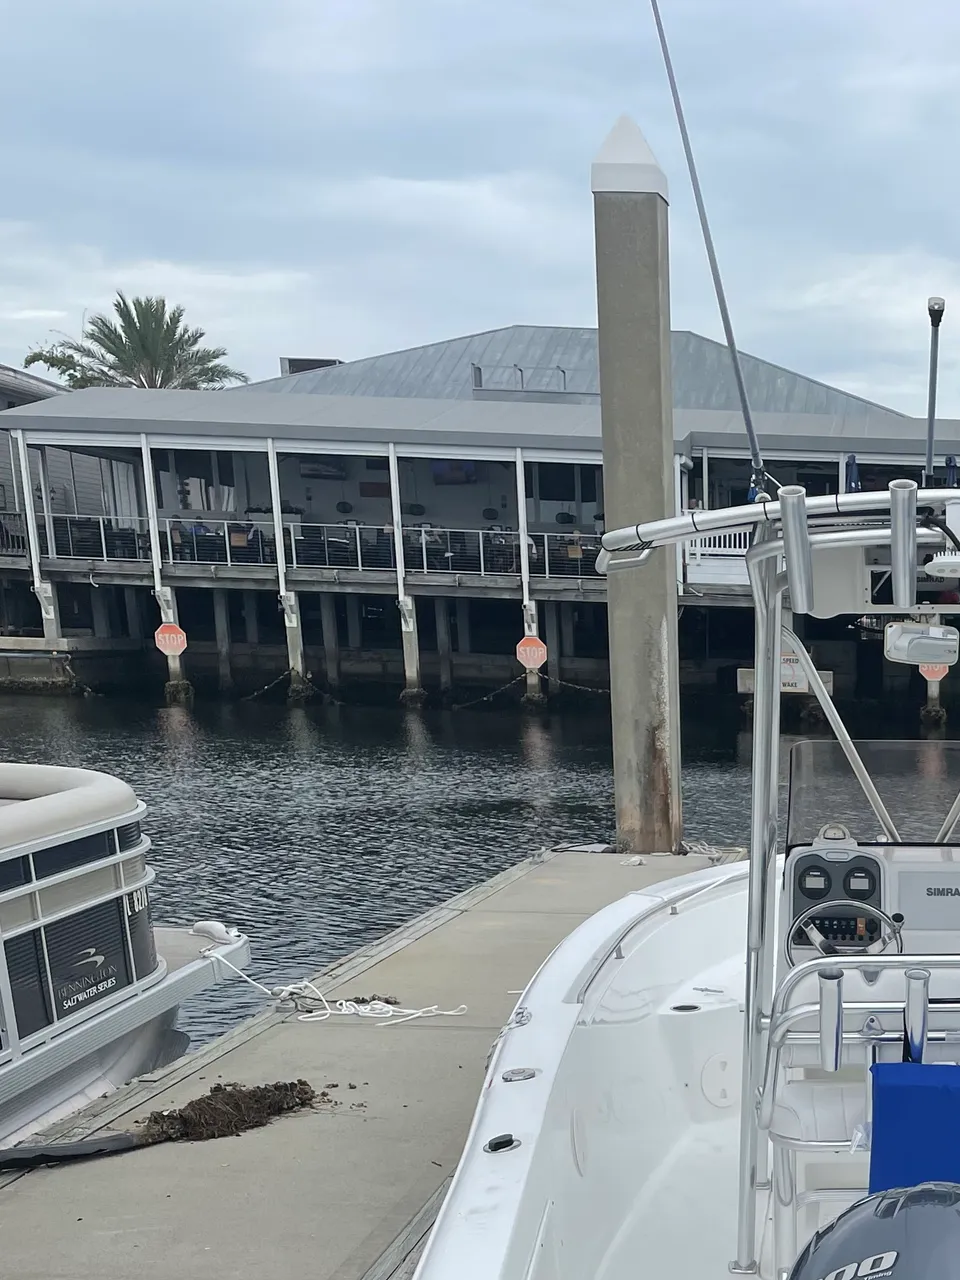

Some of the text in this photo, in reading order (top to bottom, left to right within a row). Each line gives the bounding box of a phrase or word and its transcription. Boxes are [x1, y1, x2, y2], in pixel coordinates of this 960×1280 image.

[158, 634, 184, 645] STOP
[519, 646, 545, 658] STOP
[58, 964, 118, 1000] BENNINGTON
[63, 976, 117, 1010] SALTWATER SERIES
